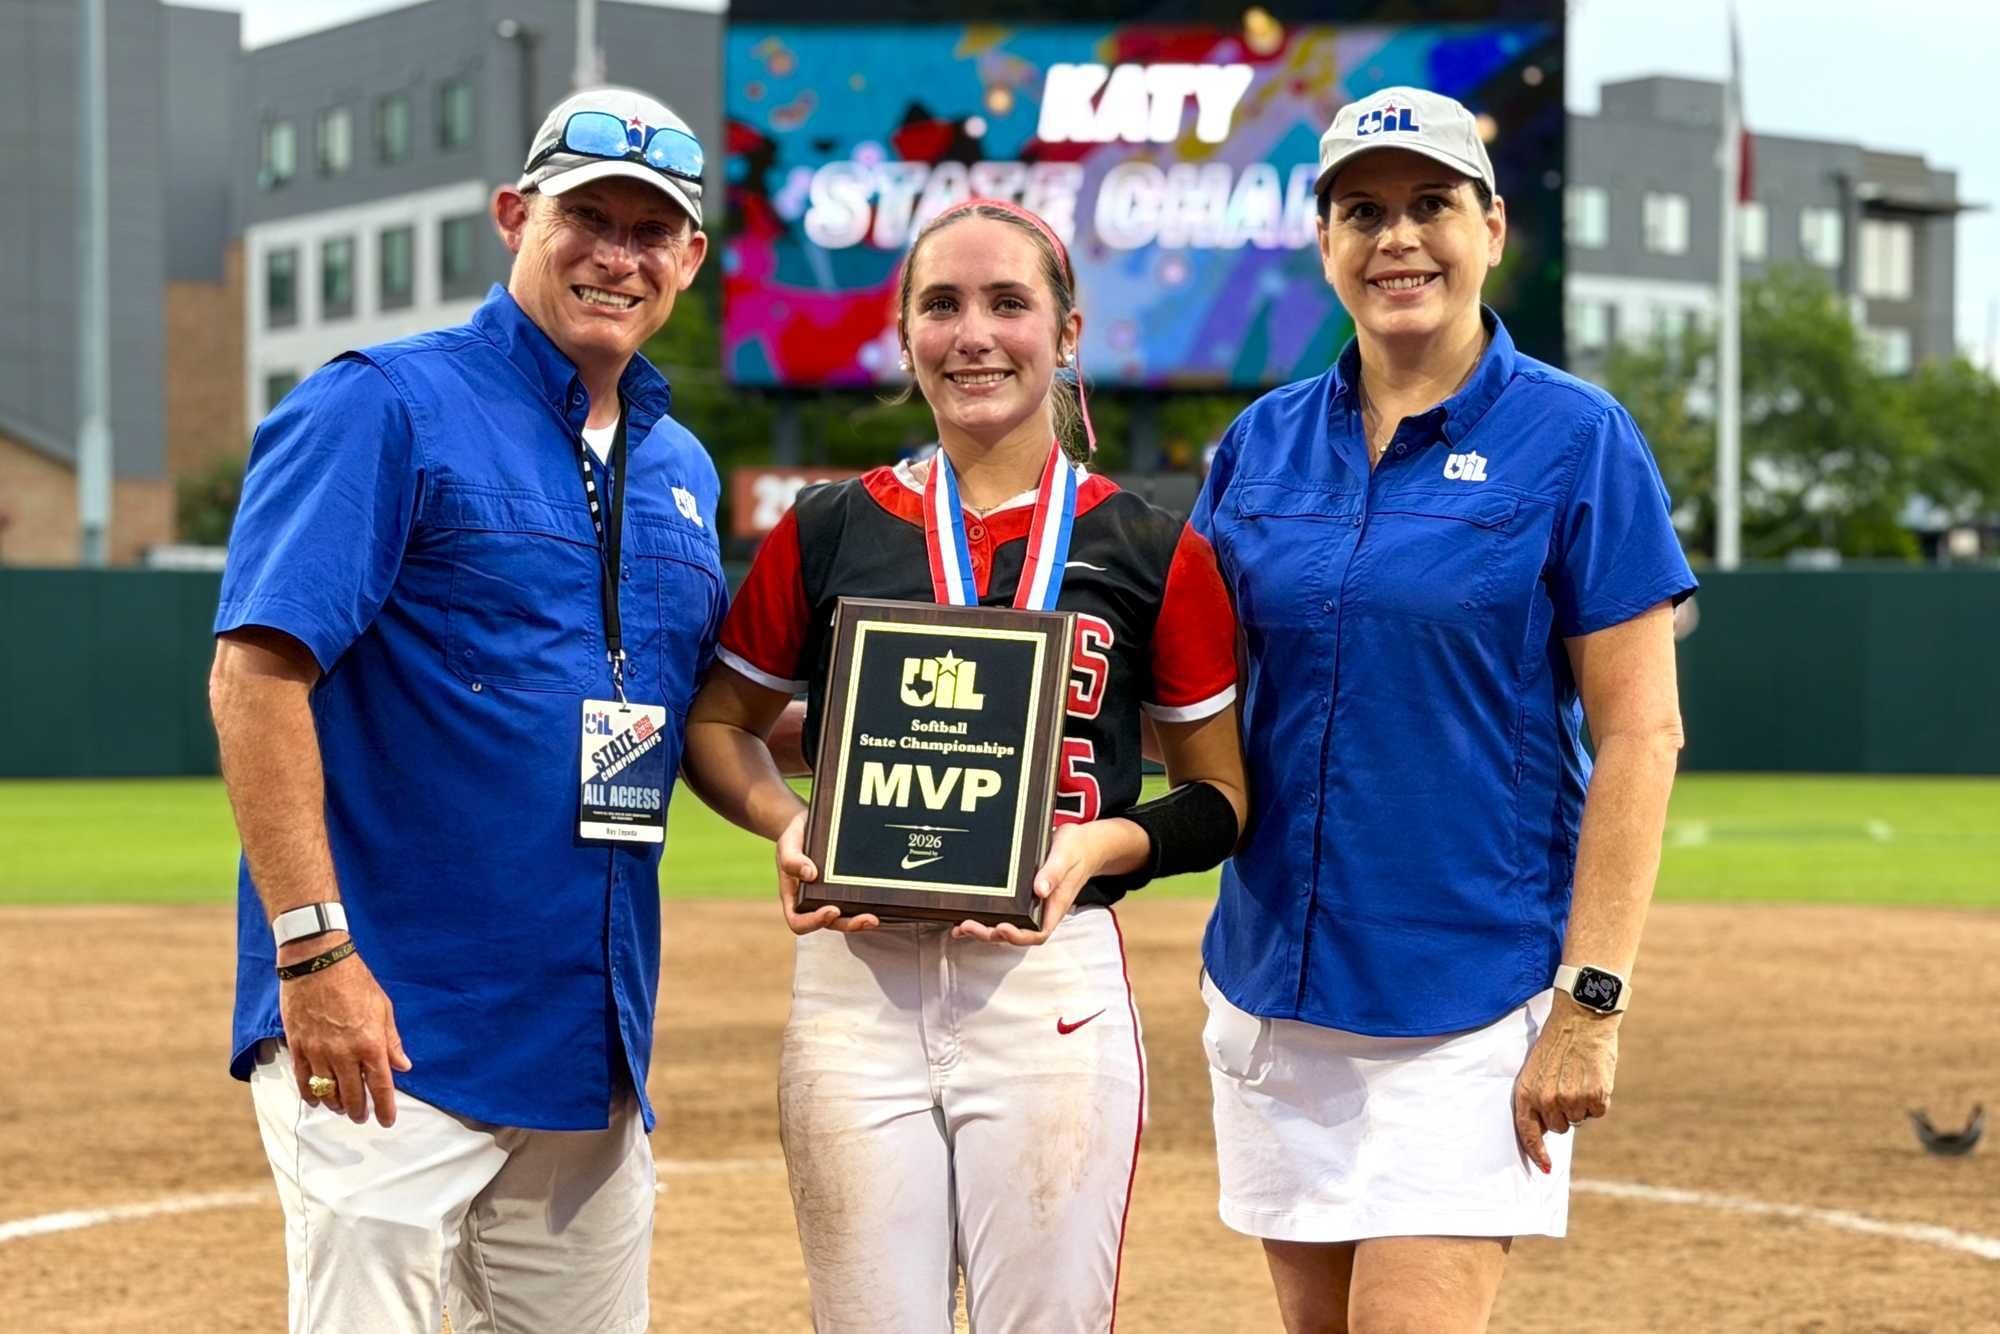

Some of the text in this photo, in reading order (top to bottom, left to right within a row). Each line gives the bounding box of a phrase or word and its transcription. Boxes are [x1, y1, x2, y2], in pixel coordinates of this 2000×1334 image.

[1037, 63, 1254, 143] KATY
[911, 719, 967, 734] Softball
[591, 728, 638, 773] STATE
[601, 733, 661, 782] CHAMPIONSHIPS
[859, 734, 1015, 757] State Championships
[583, 783, 660, 810] ALL ACCESS
[859, 761, 1002, 812] MVP
[908, 833, 942, 848] 2026
